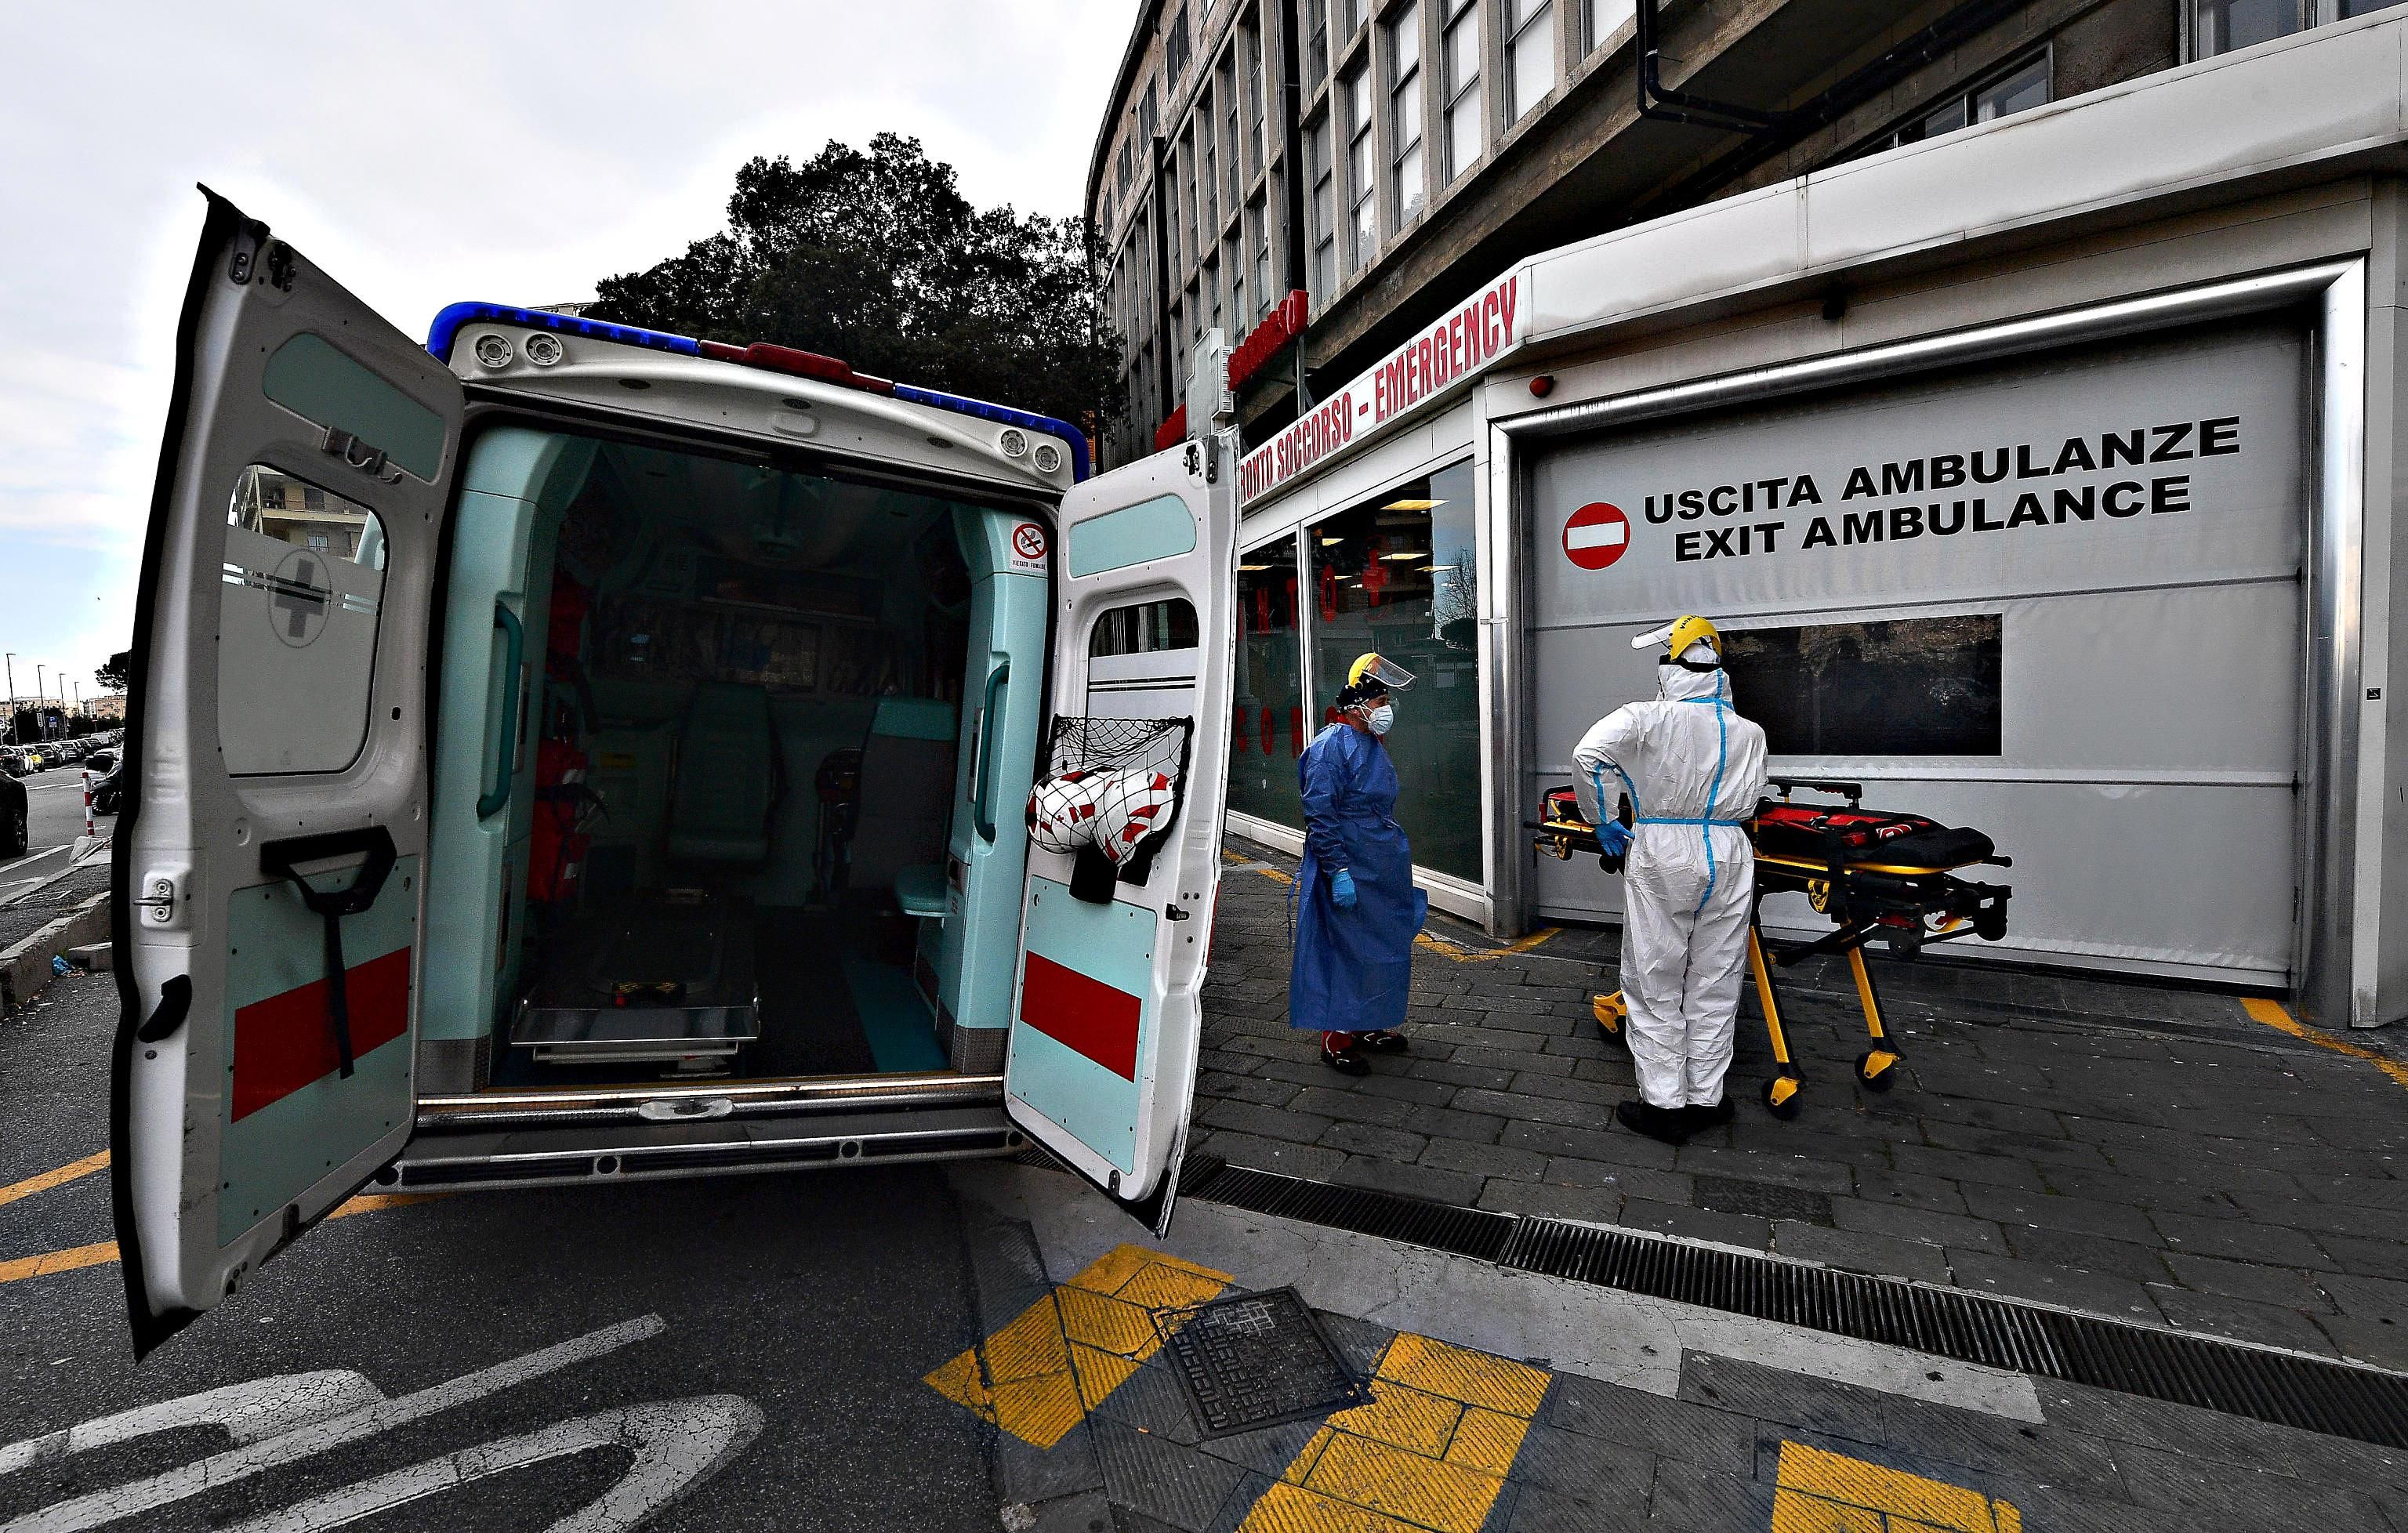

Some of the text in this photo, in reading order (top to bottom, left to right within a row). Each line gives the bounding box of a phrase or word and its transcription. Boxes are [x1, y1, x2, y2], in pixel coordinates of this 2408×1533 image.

[1277, 391, 1352, 481] SOCCORSO
[1375, 275, 1517, 424] EMERGENCY
[1645, 415, 2240, 525] USCITA AMBULANZE
[1675, 474, 2191, 562] EXIT AMBULANCE
